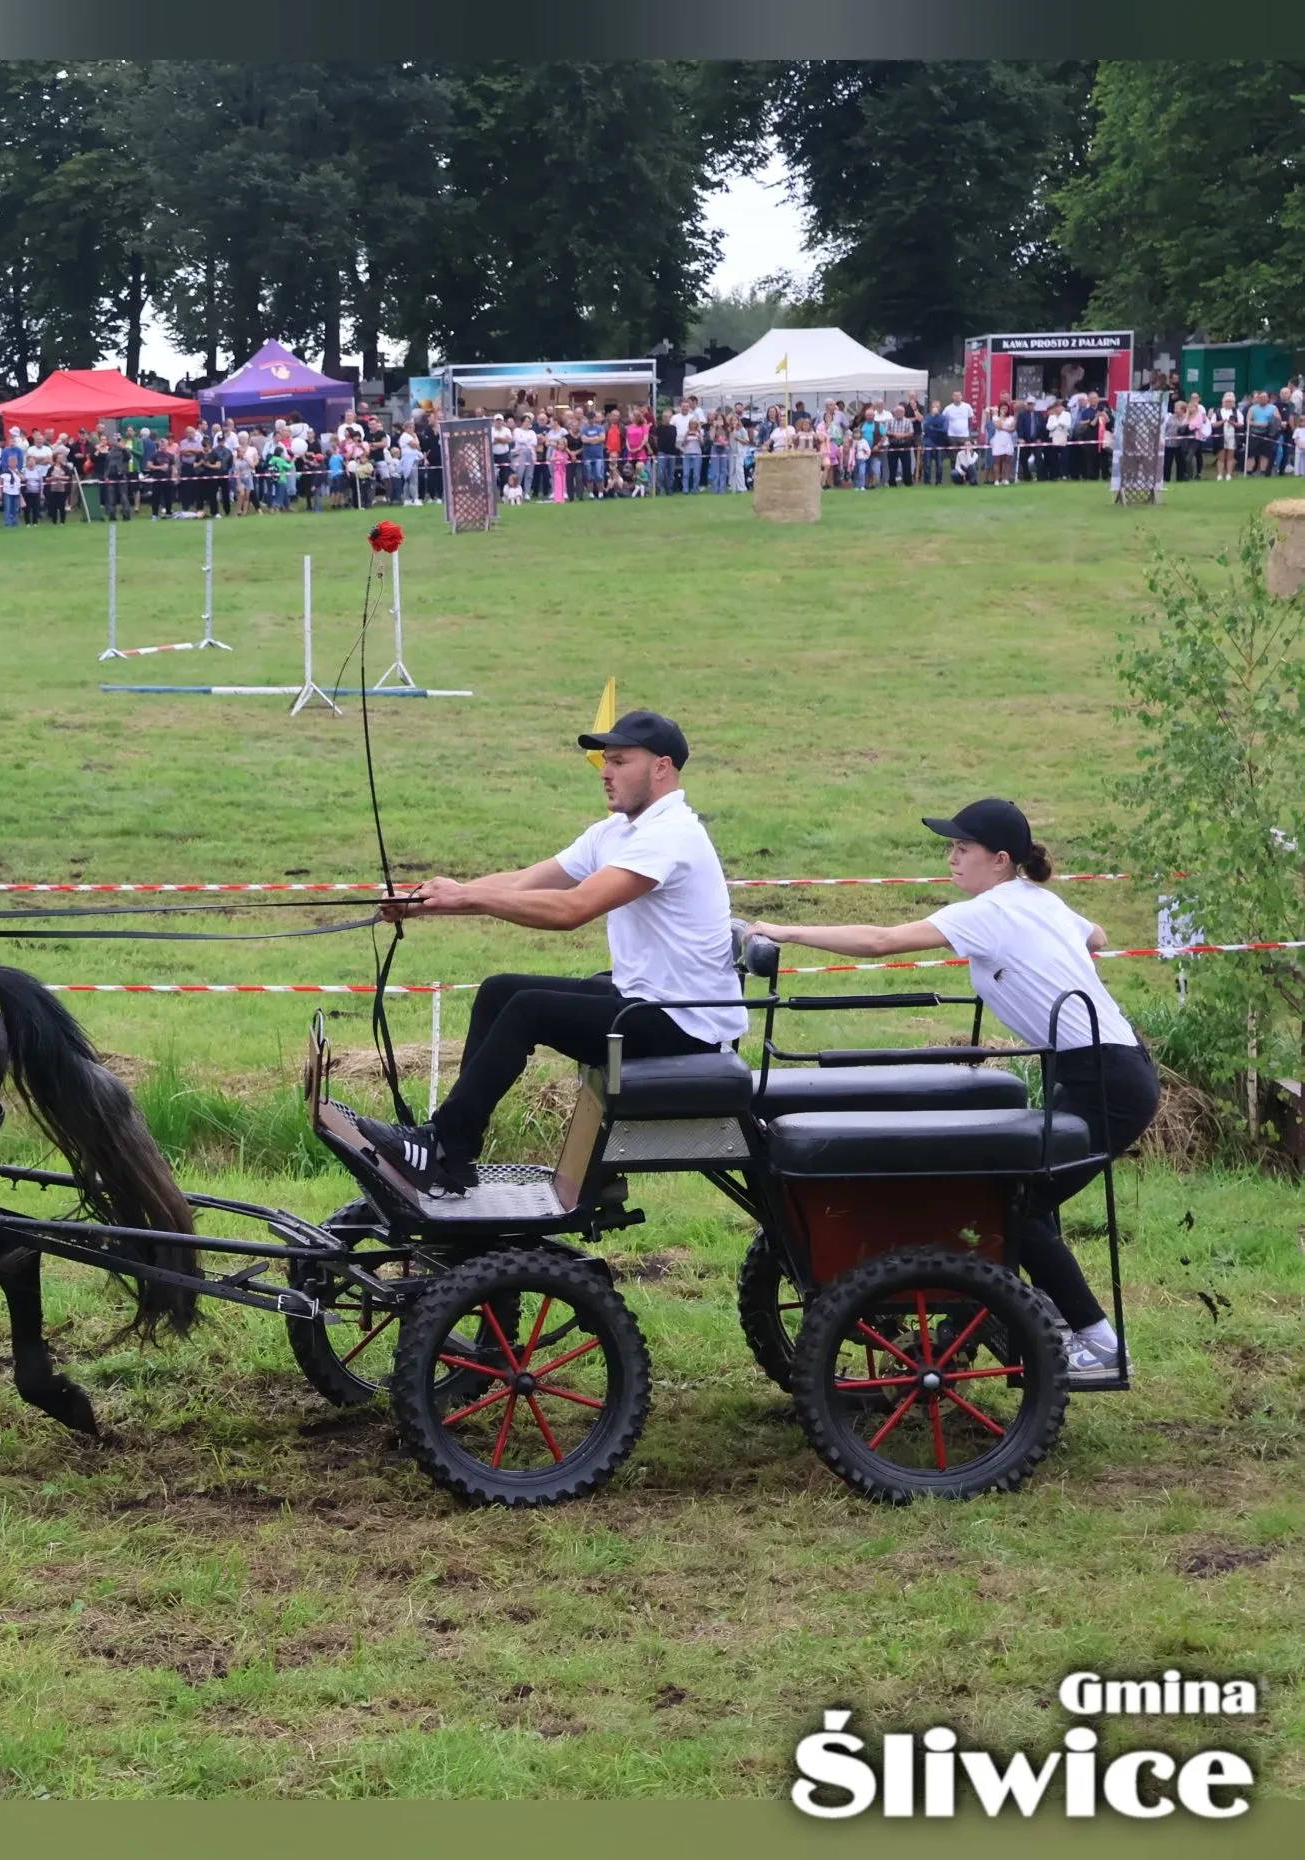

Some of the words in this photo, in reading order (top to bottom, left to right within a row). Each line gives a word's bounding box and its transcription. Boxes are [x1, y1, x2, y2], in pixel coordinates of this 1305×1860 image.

[1002, 340, 1029, 349] KAWA
[1030, 339, 1069, 348] PROSTO
[1070, 338, 1077, 347] Z
[1078, 337, 1121, 347] PALARNI
